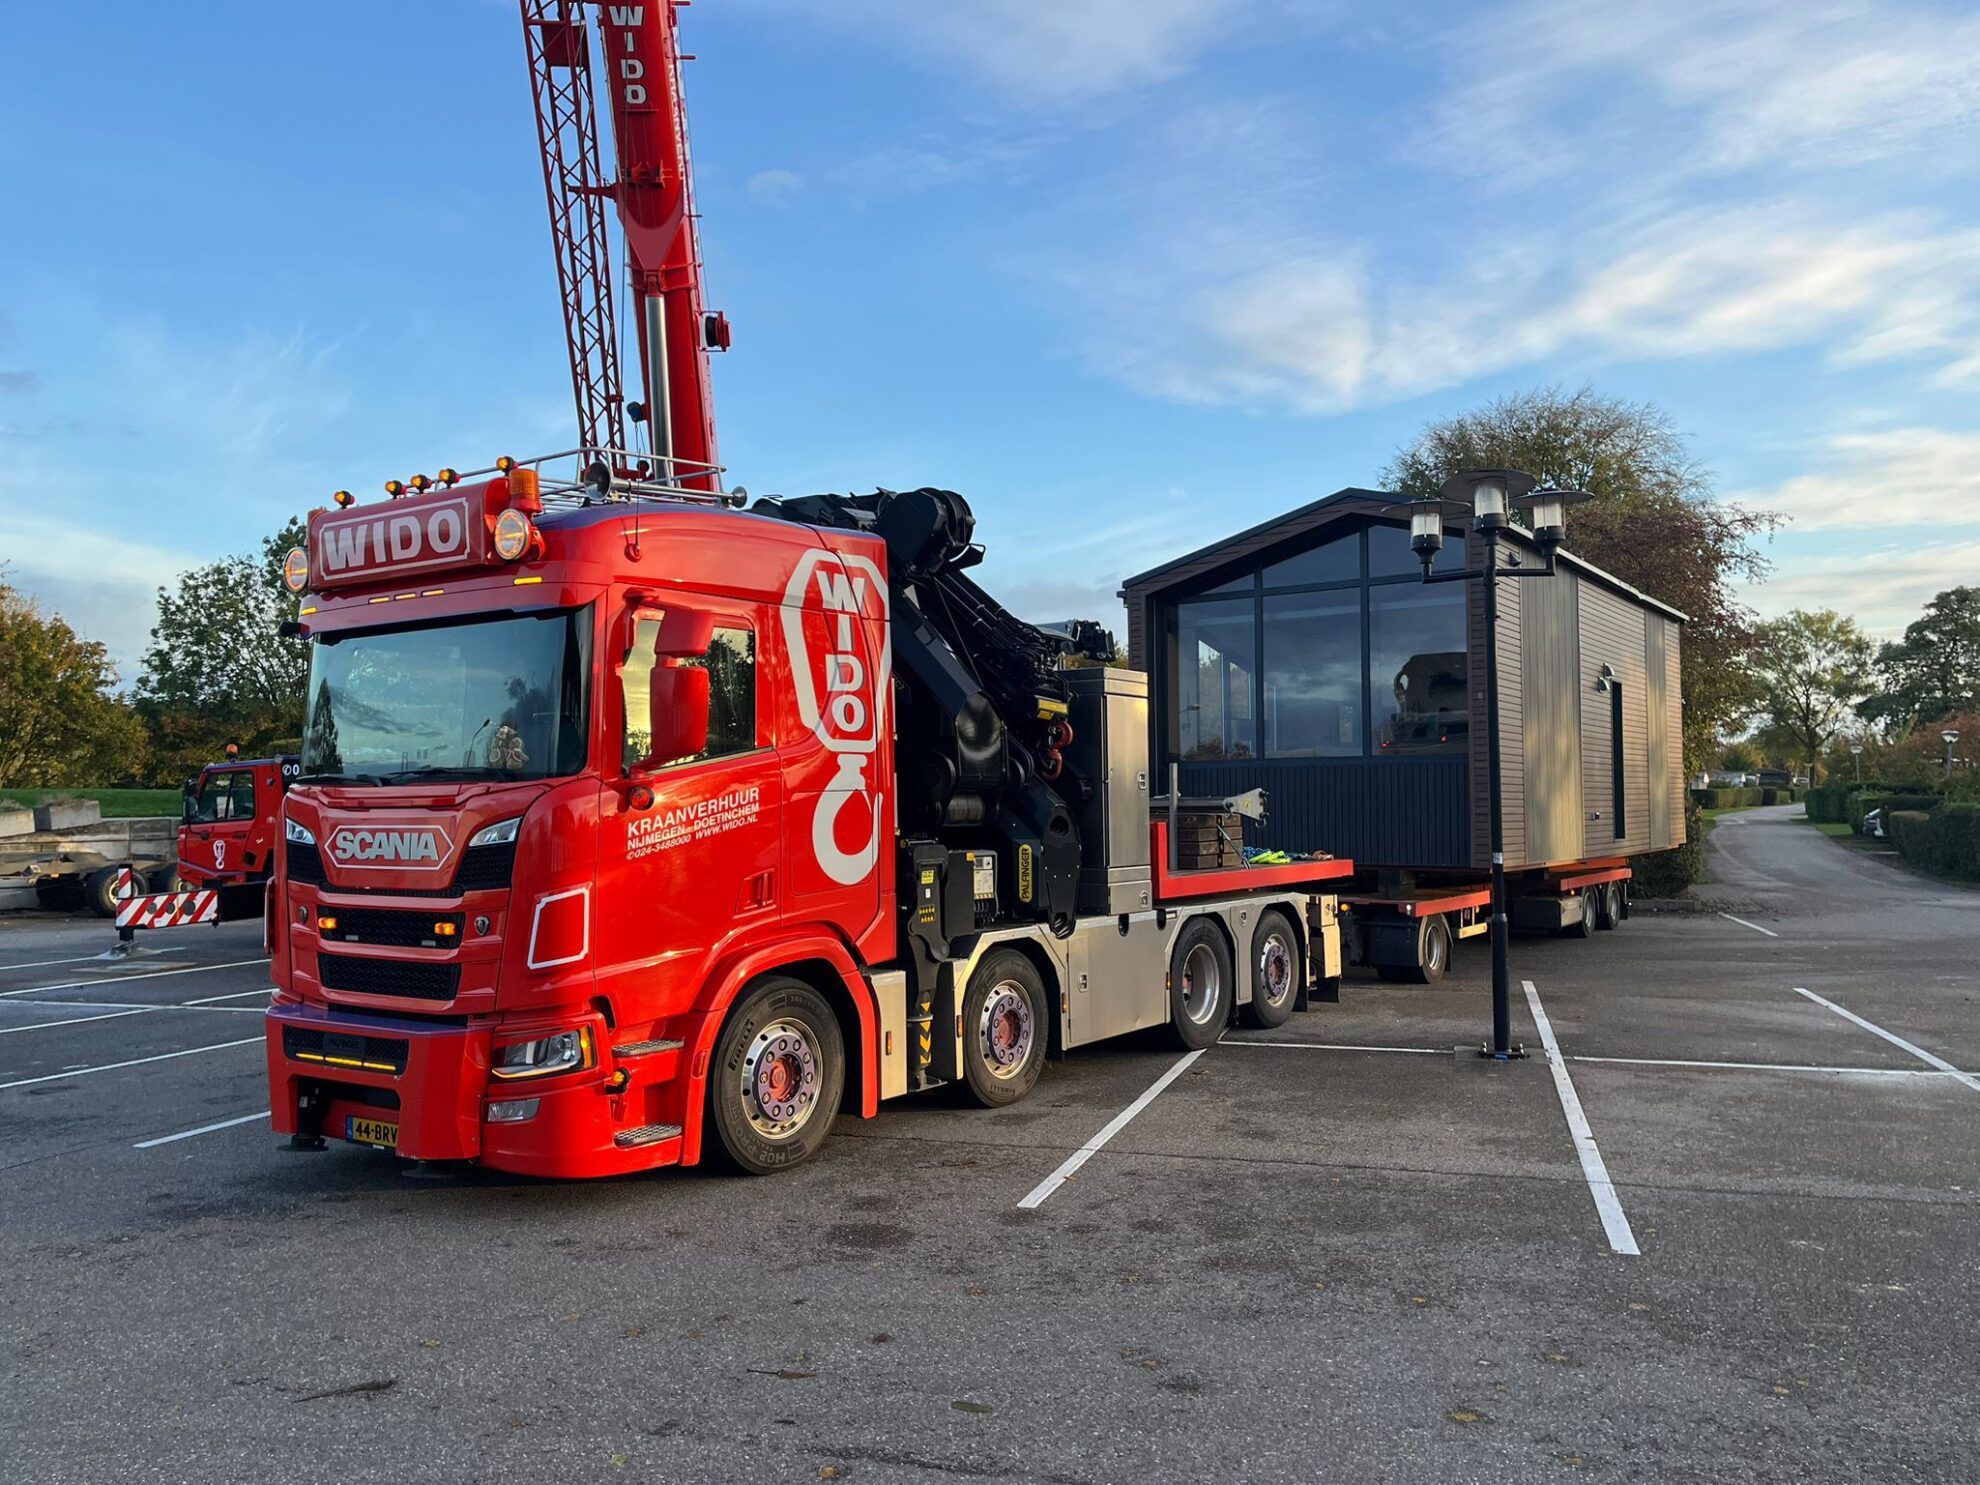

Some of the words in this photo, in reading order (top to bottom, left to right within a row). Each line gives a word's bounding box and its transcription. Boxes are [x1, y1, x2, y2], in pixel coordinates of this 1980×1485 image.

[609, 5, 648, 105] WIDO
[323, 508, 462, 571] WIDO
[815, 569, 867, 733] WIDO
[627, 786, 760, 838] KRAANVERHUUR
[627, 824, 686, 850] NIJMEGEN
[693, 802, 760, 831] DOETINCHEM
[695, 813, 759, 840] WWW.WIDO.NL
[334, 831, 440, 861] SCANIA
[1021, 847, 1030, 900] PALFINGER
